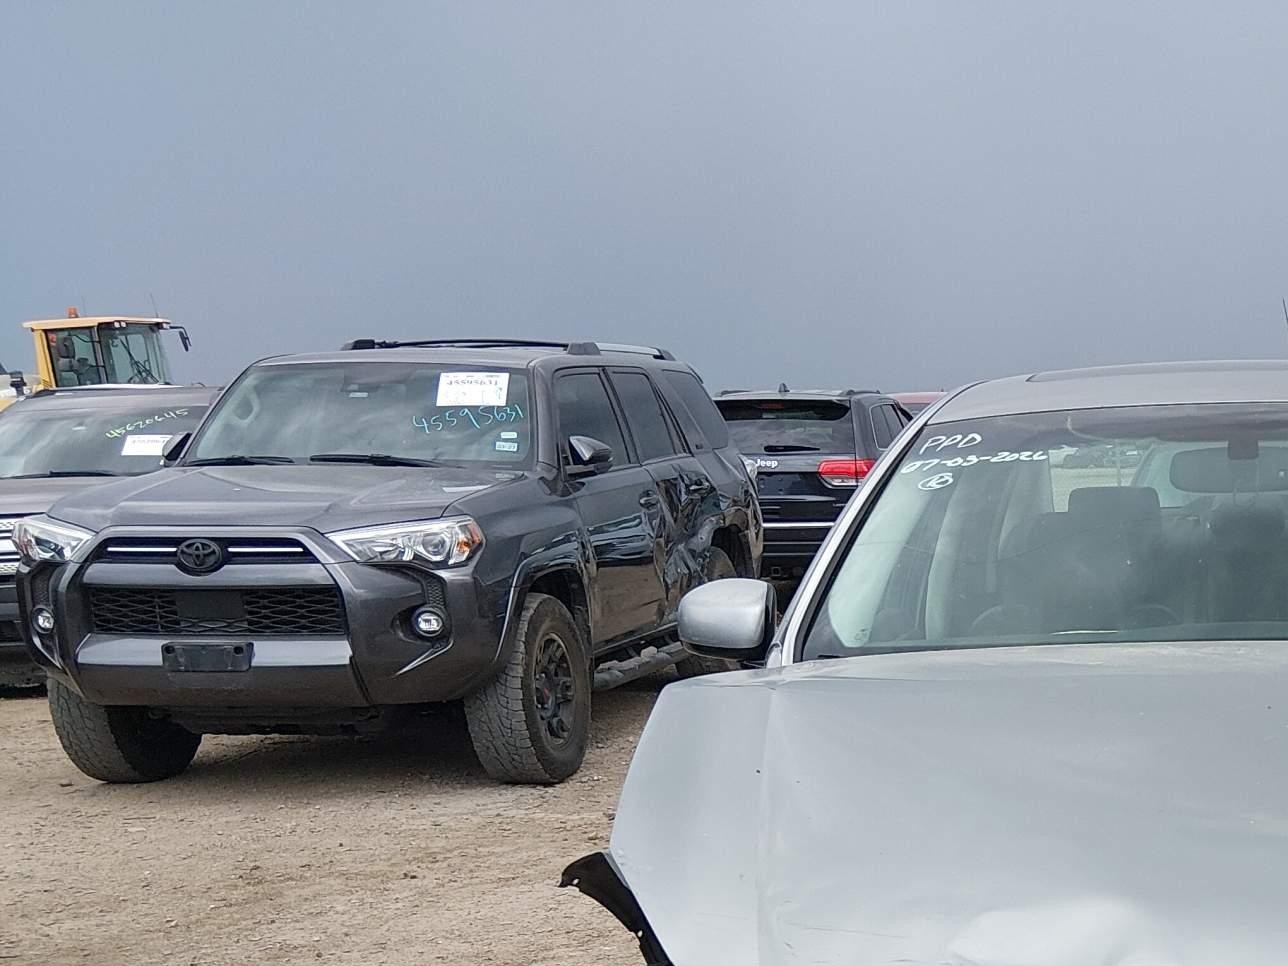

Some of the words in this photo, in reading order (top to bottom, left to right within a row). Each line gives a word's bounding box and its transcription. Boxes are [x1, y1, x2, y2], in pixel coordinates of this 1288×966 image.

[413, 404, 524, 434] 45595631
[919, 433, 982, 455] PPD
[755, 459, 779, 469] Jeep
